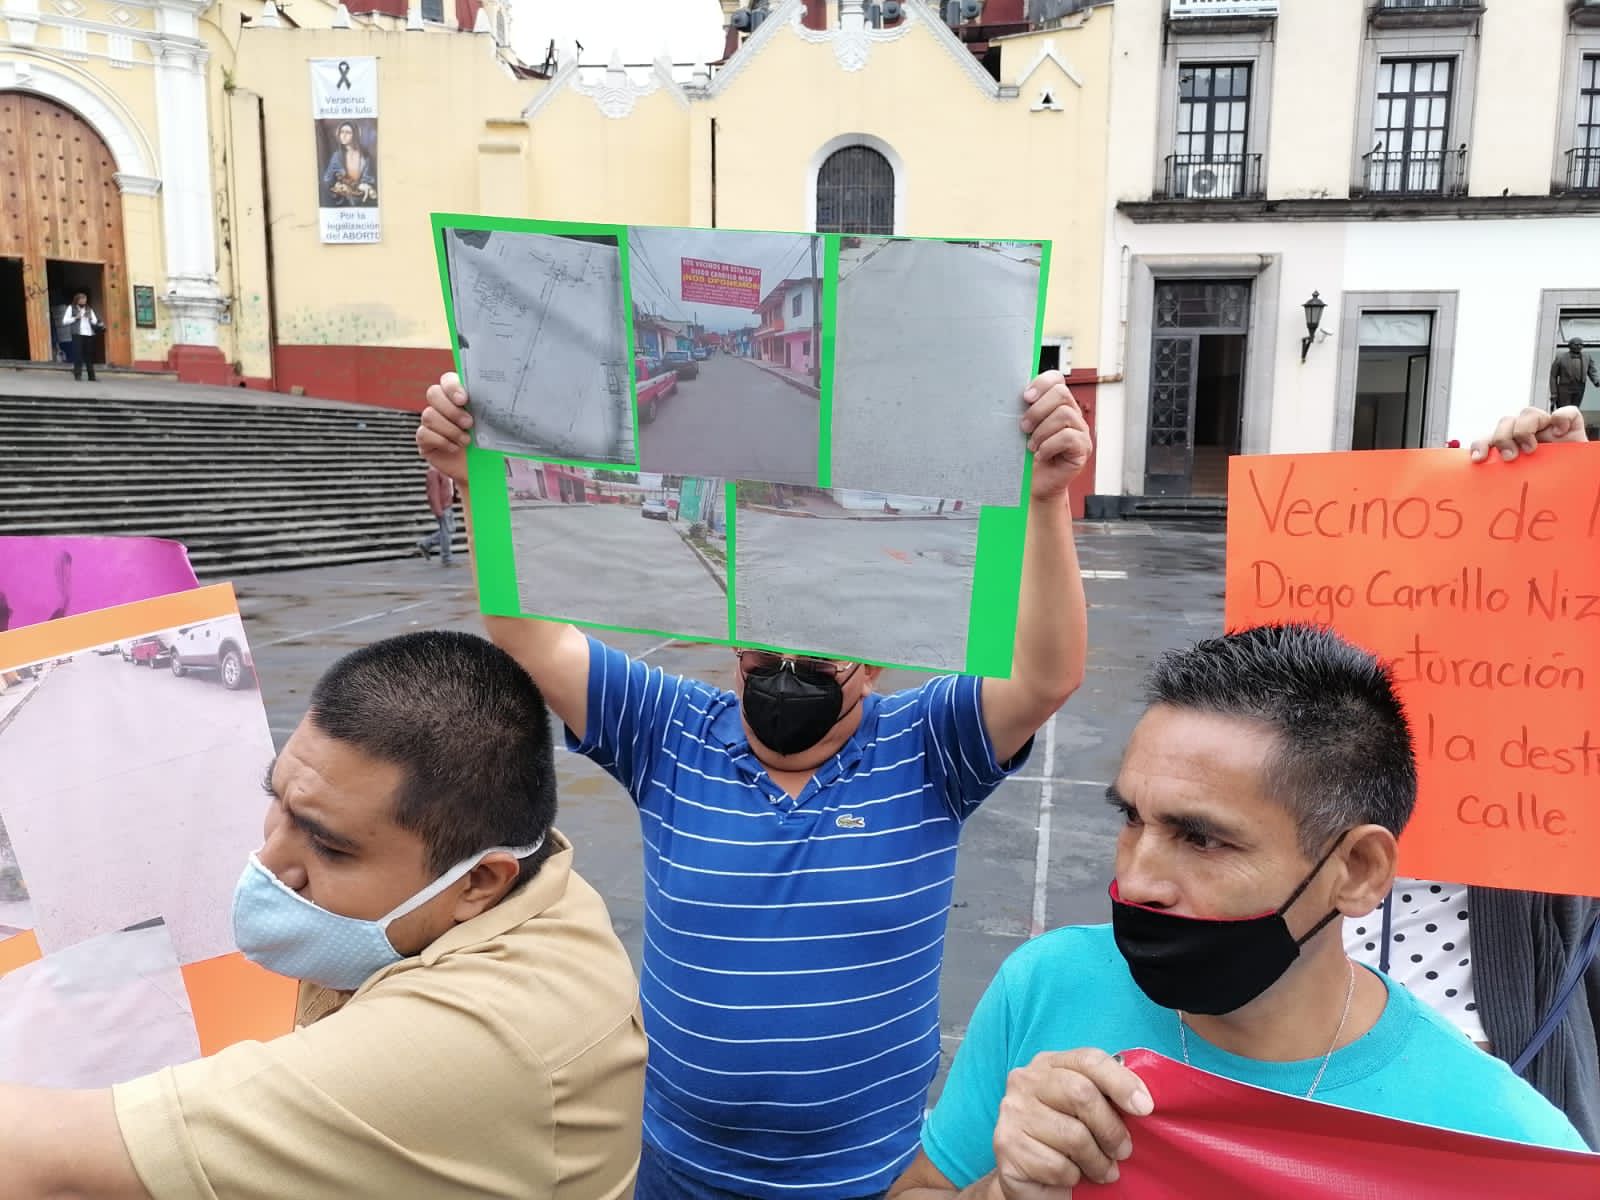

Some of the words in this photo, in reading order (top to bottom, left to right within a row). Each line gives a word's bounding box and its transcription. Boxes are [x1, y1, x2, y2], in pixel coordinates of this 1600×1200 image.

[324, 95, 366, 104] Veracruz
[341, 105, 353, 113] de
[340, 211, 354, 220] Por
[357, 210, 367, 220] la
[326, 231, 341, 241] del
[342, 231, 382, 241] ABORTO
[1249, 462, 1464, 540] Vecinos
[1488, 481, 1559, 544] de
[1250, 559, 1355, 625] Diego
[1365, 567, 1510, 613] Carrillo
[1428, 712, 1476, 761] la
[1499, 724, 1600, 777] dest
